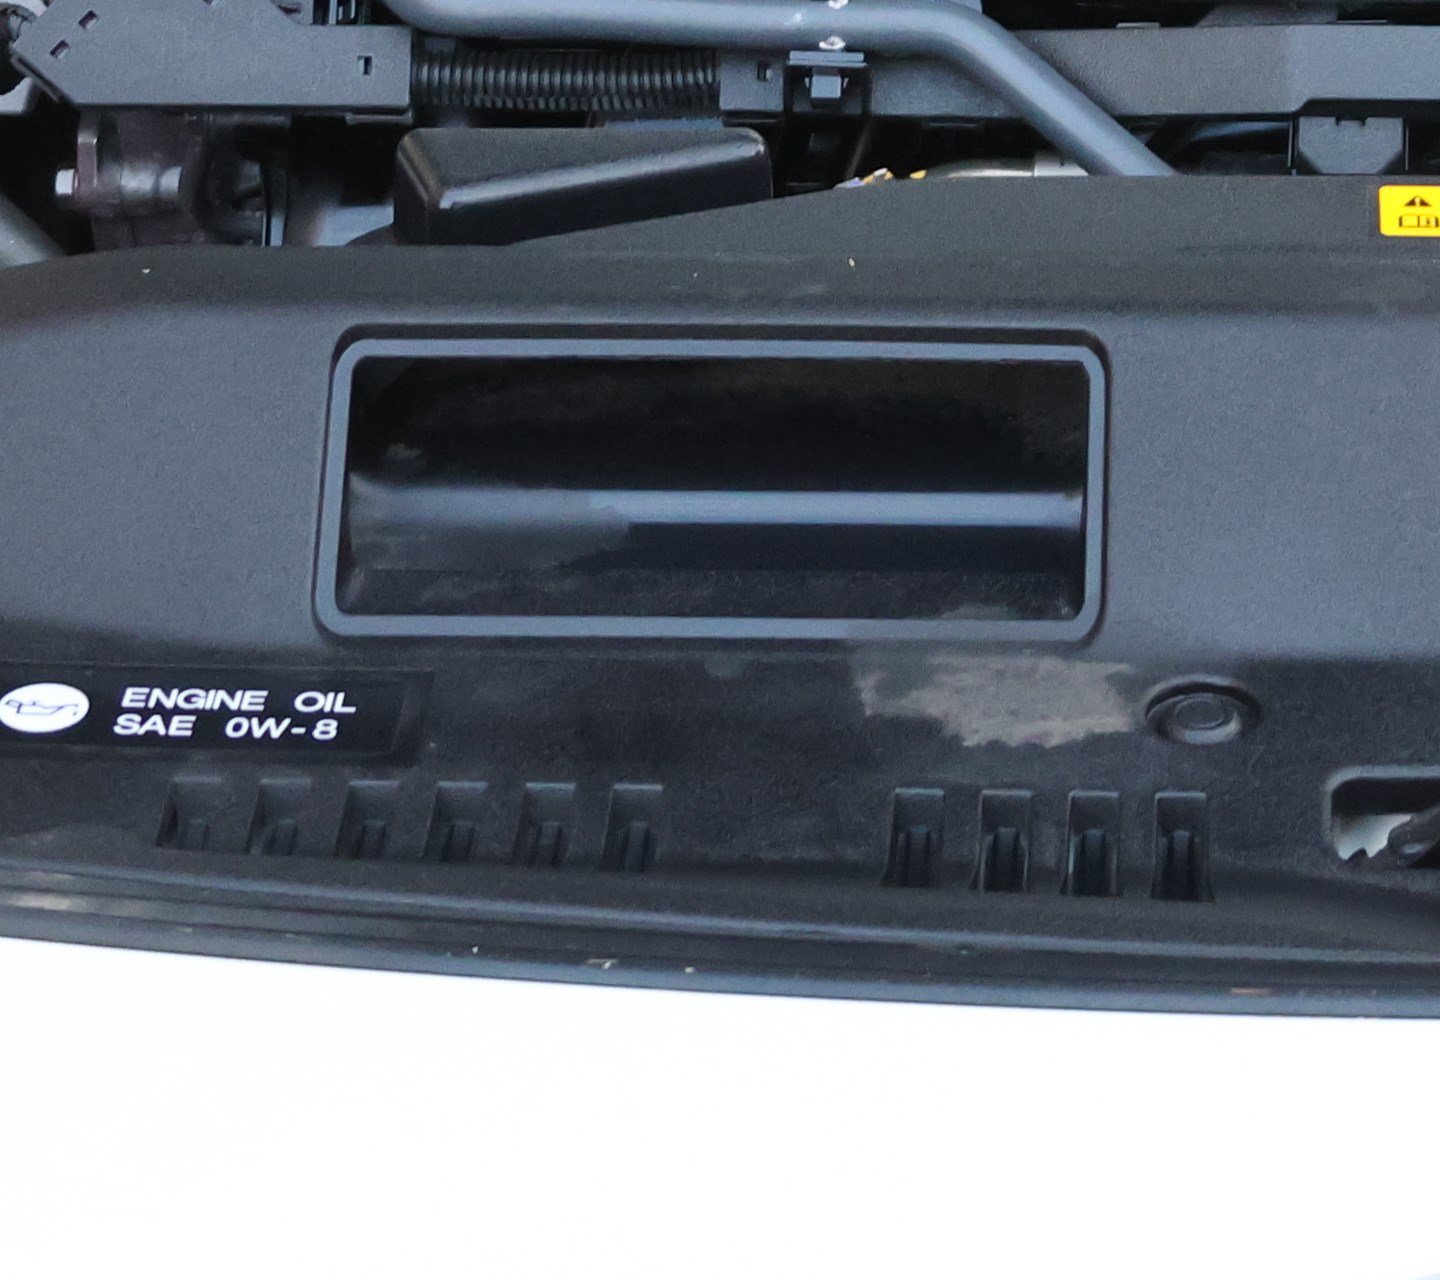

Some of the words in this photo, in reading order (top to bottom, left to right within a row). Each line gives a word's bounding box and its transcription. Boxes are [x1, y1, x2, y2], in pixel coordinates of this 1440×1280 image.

[121, 686, 269, 712] ENGINE
[294, 691, 357, 714] OIL
[113, 712, 198, 738] SAE
[225, 716, 339, 740] 0W-8
